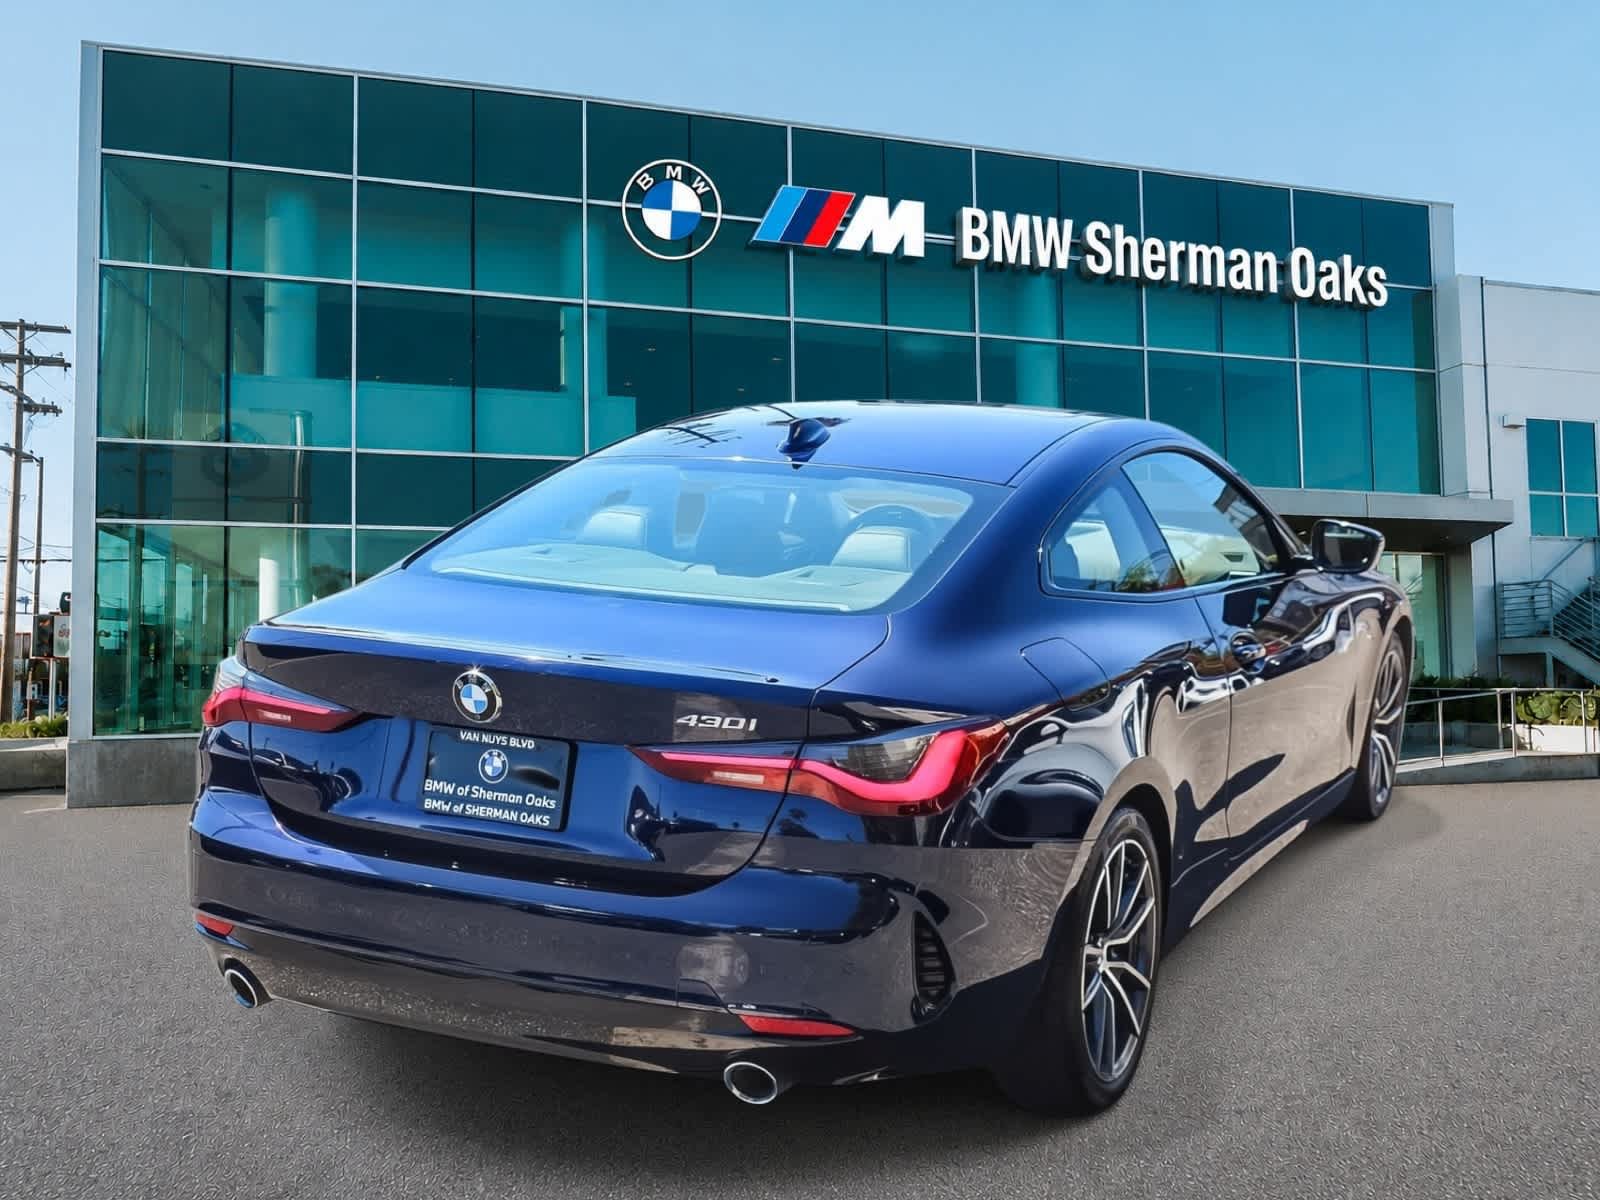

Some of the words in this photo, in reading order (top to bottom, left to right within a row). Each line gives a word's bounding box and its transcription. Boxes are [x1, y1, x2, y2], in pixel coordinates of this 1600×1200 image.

[636, 165, 711, 195] BMW
[960, 206, 1073, 270] BMW
[1083, 220, 1279, 294] Sherman
[1287, 247, 1388, 308] Oaks
[460, 730, 480, 742] VAN
[481, 733, 508, 746] NUYS
[509, 736, 535, 749] BLVD
[424, 779, 456, 795] BMW
[457, 784, 471, 797] of
[471, 785, 523, 804] Sherman
[525, 793, 557, 809] Oaks
[424, 798, 452, 812] BMW
[452, 803, 464, 813] of
[465, 804, 518, 821] SHERMAN
[520, 812, 551, 826] OAKS
